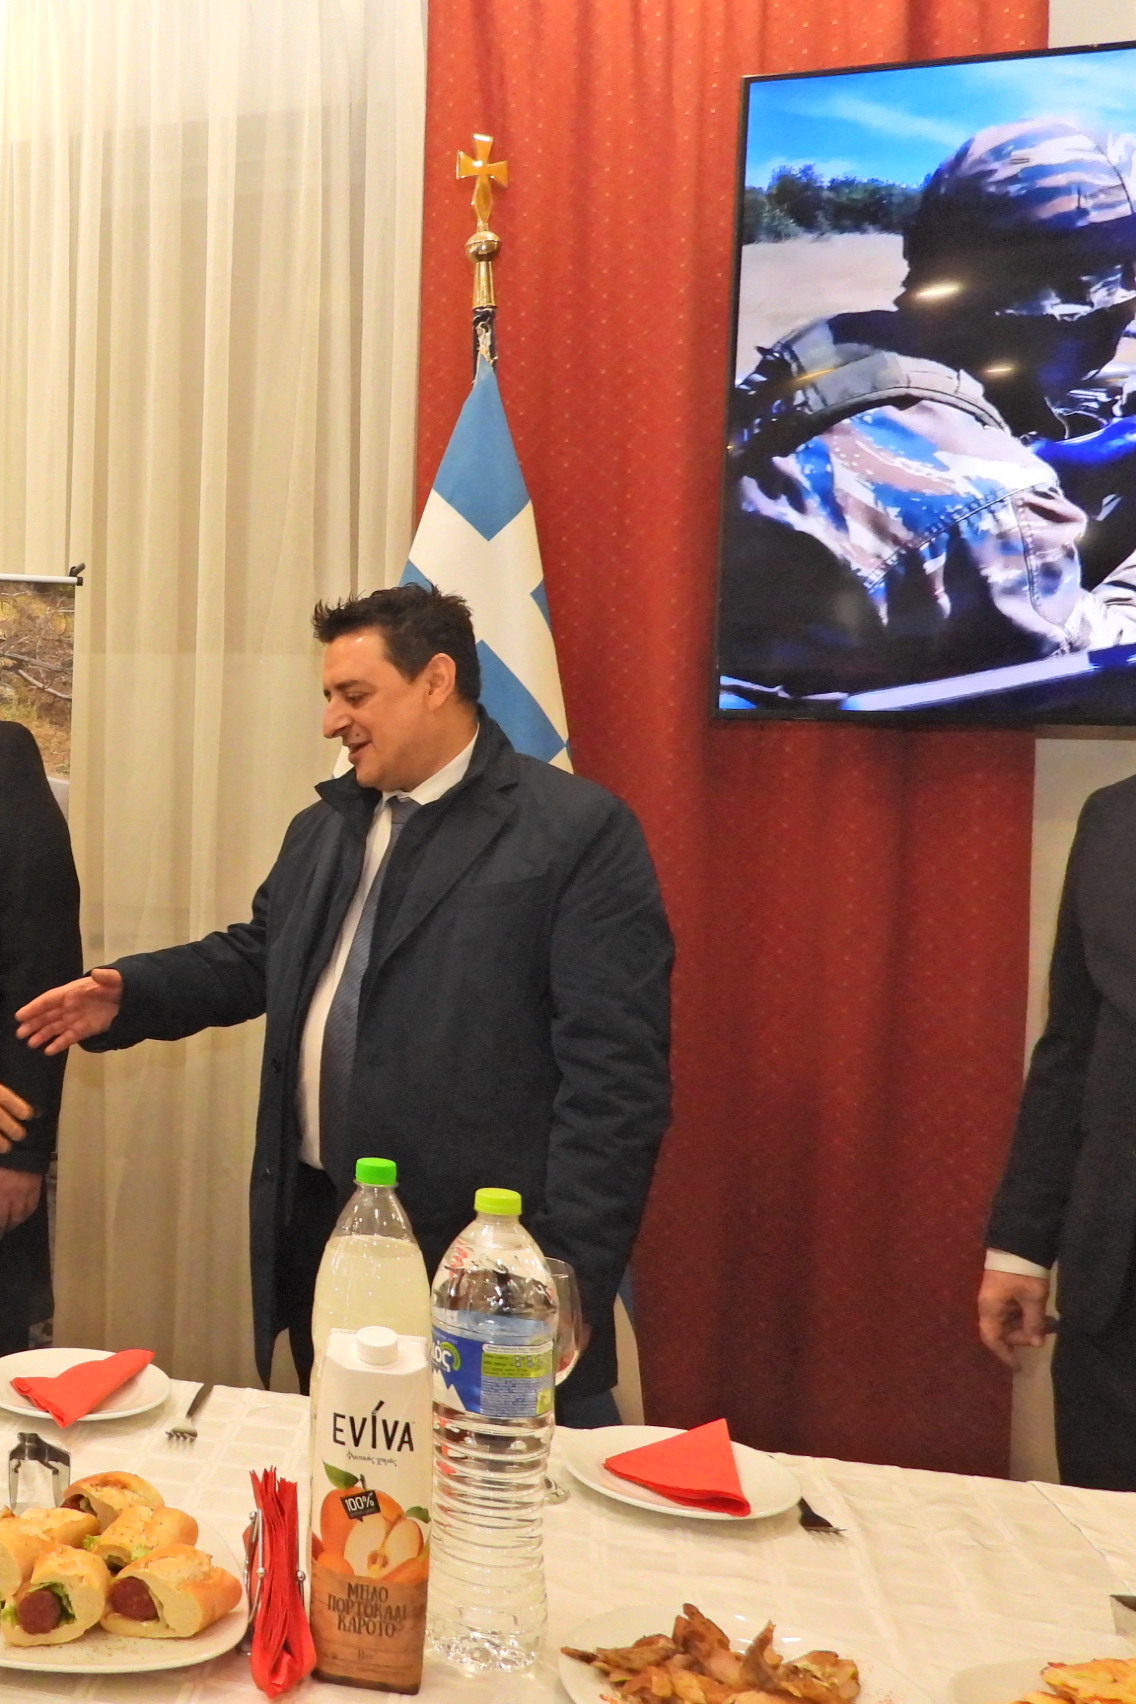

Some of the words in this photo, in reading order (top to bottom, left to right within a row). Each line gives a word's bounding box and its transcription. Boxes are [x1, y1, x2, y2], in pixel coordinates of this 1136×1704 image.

[345, 1493, 375, 1512] 100%
[347, 1582, 389, 1603] ΜΗΛΟ
[337, 1614, 396, 1638] ΚΑΡΟΤΟ
